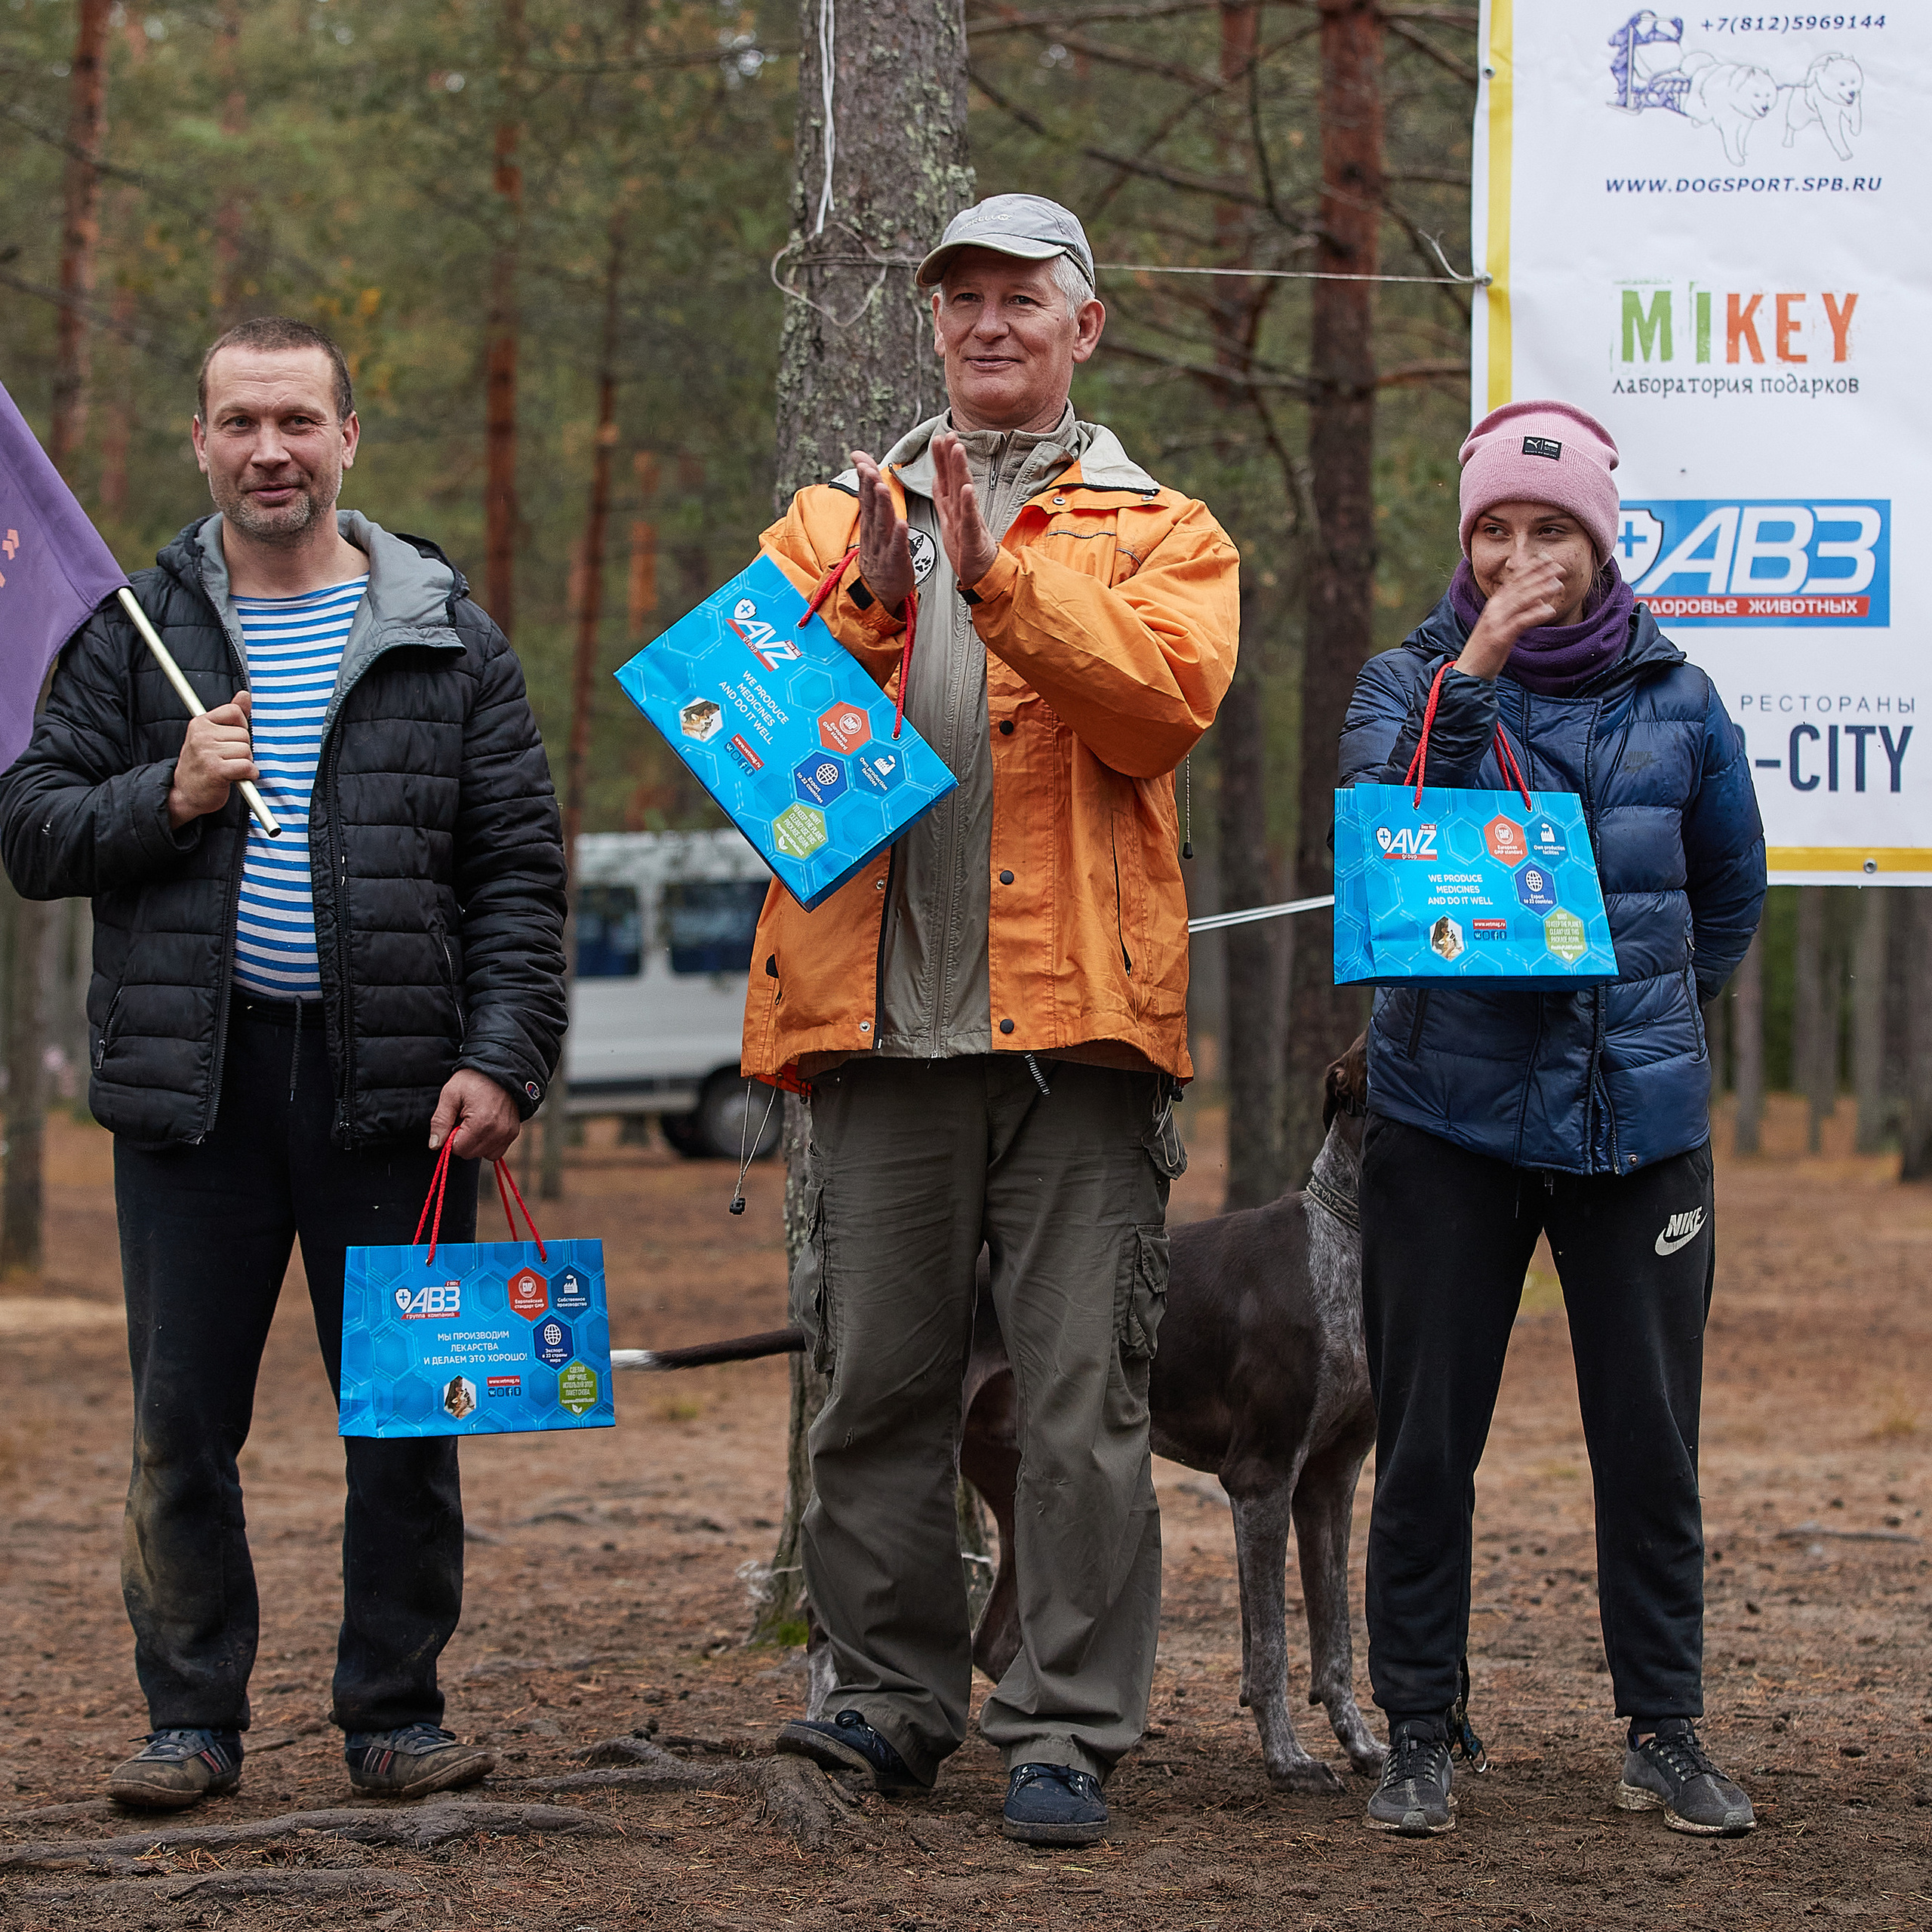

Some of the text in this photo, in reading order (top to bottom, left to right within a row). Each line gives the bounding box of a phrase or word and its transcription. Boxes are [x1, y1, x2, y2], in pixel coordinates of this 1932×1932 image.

[1701, 15, 1887, 35] +7(812)5969144
[1605, 177, 1882, 192] WWW.DOGSPORT.SPB.RU
[1621, 290, 1859, 364] MIKEY
[1613, 374, 1859, 398] лаборатория подарков
[1634, 506, 1881, 595] АВЗ
[1748, 598, 1858, 614] животных
[734, 619, 798, 669] AVZ
[743, 636, 758, 653] group
[737, 682, 776, 727] MEDICINES
[743, 670, 789, 724] WE PRODUCE
[1740, 694, 1915, 714] РЕСТОРАНЫ
[718, 681, 774, 745] AND DO IT WELL
[823, 721, 848, 750] GMP standard
[829, 722, 848, 743] European
[734, 737, 761, 769] www.vetmag.ru
[808, 777, 821, 792] Export
[860, 757, 888, 791] Own production
[861, 768, 878, 787] facilities
[806, 783, 823, 804] countries
[792, 804, 800, 812] TO
[796, 809, 808, 821] KEEP
[811, 826, 826, 842] PLANET
[809, 811, 822, 825] WANT
[1386, 828, 1438, 854] AVZ
[1428, 874, 1483, 883] WE PRODUCE
[1435, 885, 1480, 894] MEDICINES
[1428, 897, 1494, 906] AND DO IT WELL
[1665, 1206, 1703, 1238] NIKE
[405, 1287, 461, 1313] АВЗ
[453, 1331, 509, 1341] ПРОИЗВОДИМ
[451, 1343, 499, 1352] ЛЕКАРСТВА
[423, 1352, 528, 1366] И ДЕЛАЕМ ЭТО ХОРОШО!
